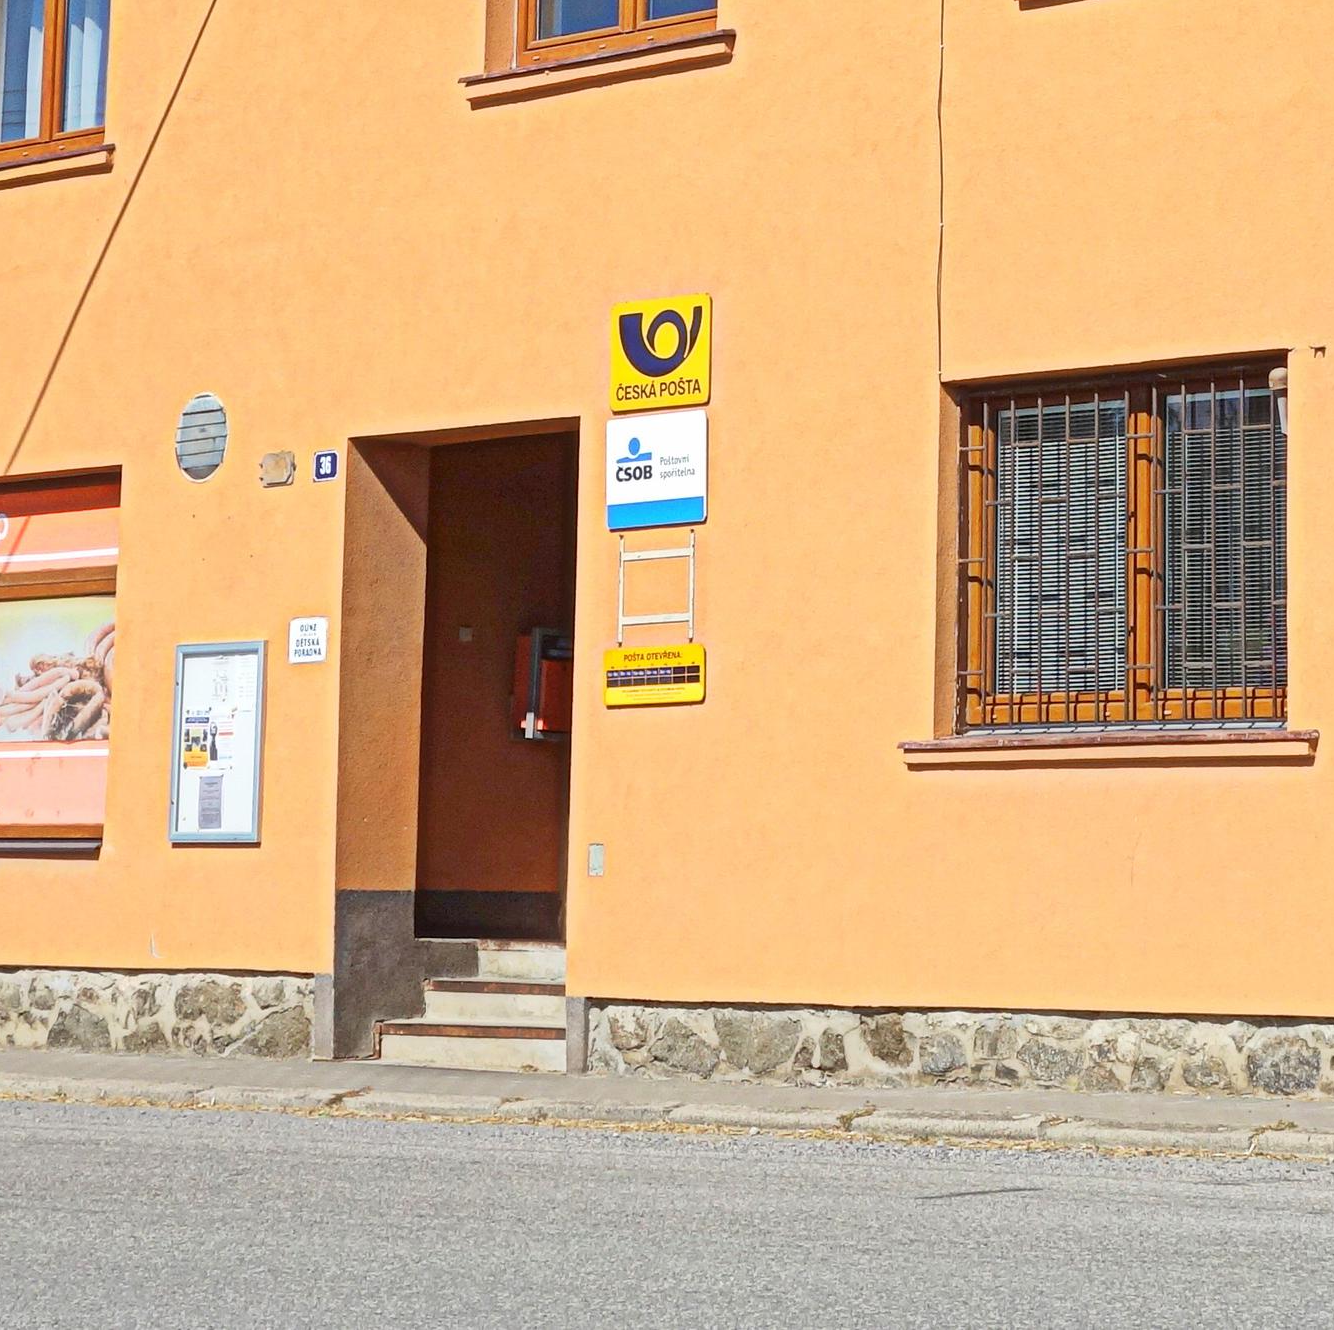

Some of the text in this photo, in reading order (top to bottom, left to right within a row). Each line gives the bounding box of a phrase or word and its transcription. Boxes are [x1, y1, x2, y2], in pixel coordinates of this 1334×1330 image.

[616, 377, 701, 401] ČESKÁ POŠTA
[319, 455, 332, 475] 36
[659, 454, 690, 466] Poštovní
[616, 465, 653, 482] ČSOB
[659, 468, 695, 480] spořitelna
[623, 651, 681, 662] POŠTA OTEVŘENA
